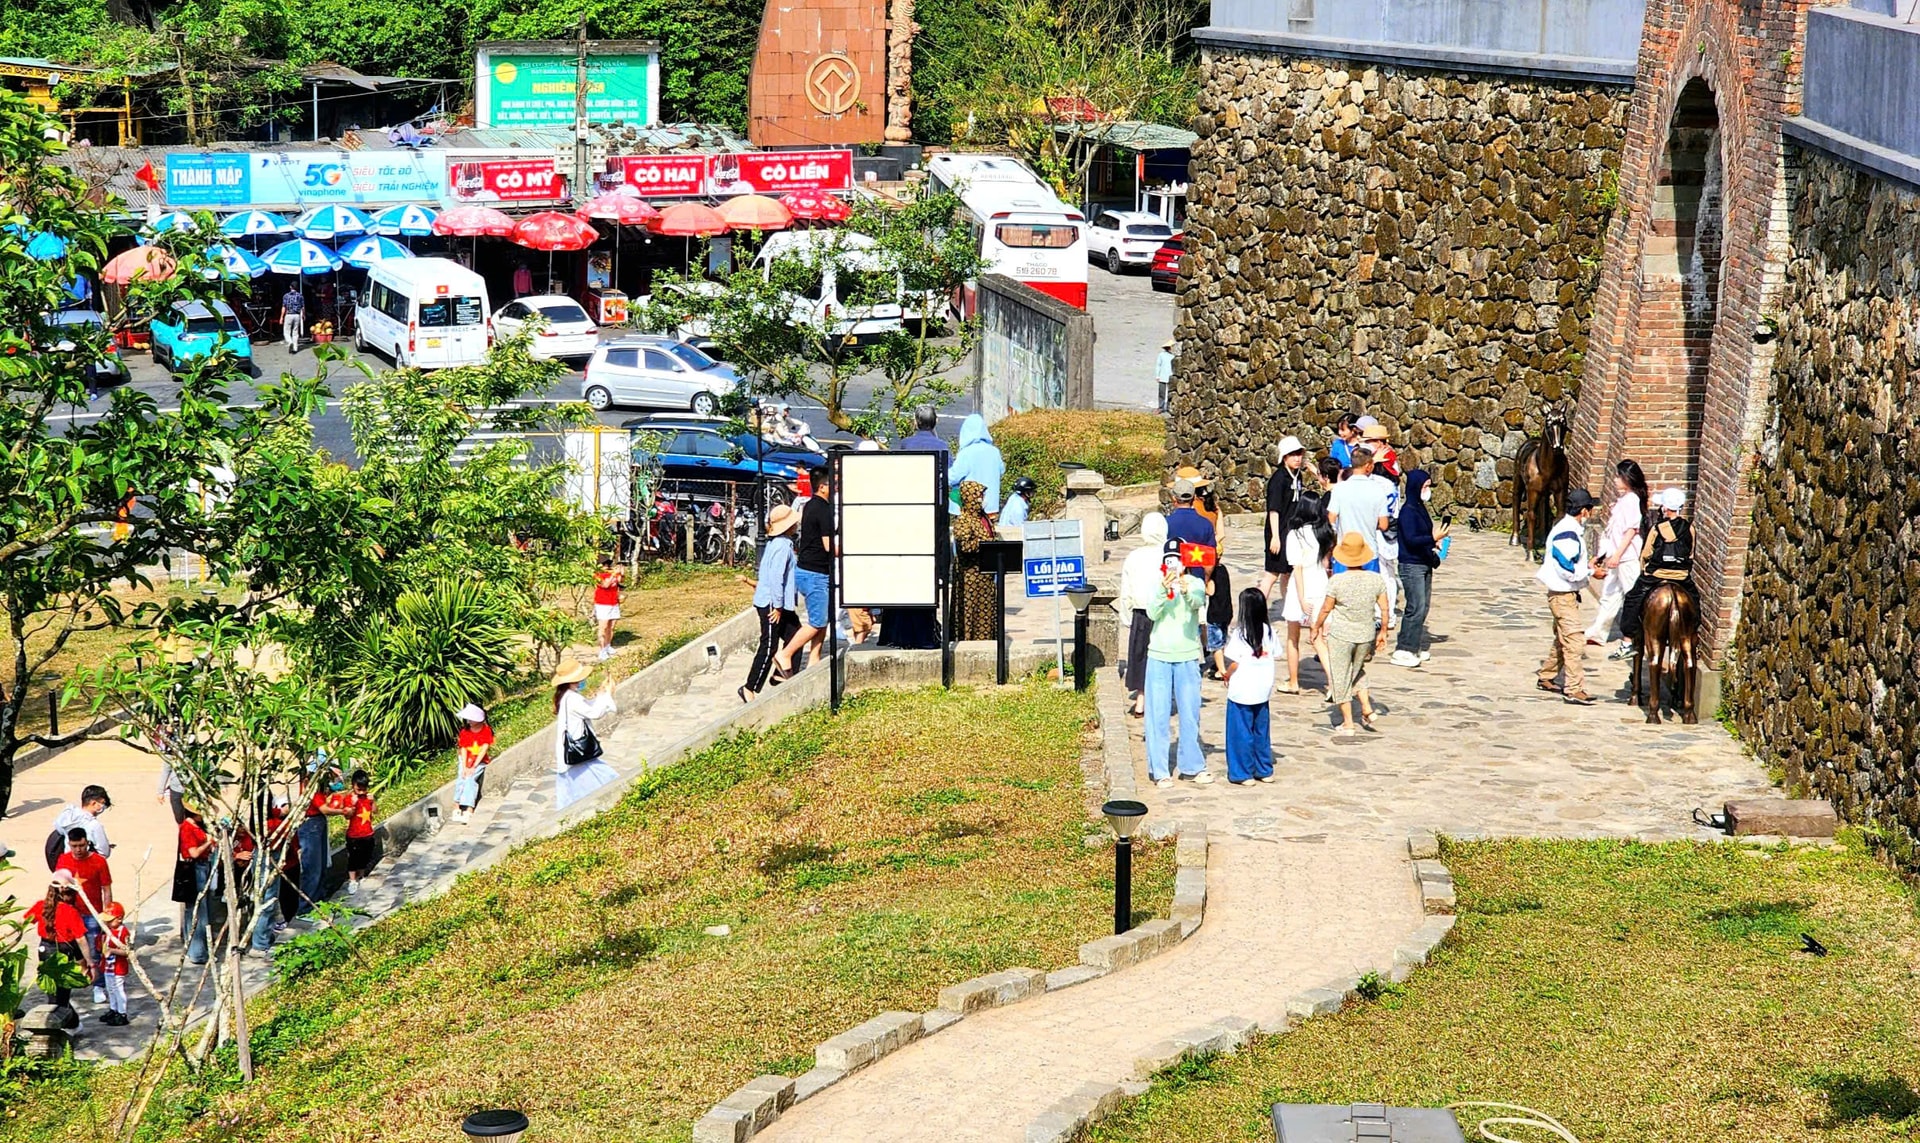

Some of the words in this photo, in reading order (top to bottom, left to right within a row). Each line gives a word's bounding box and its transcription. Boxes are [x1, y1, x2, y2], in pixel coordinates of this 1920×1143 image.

[171, 166, 213, 186] THÀNH
[215, 165, 243, 188] MẬP
[496, 170, 523, 189] CÔ
[635, 165, 661, 183] CÔ
[664, 167, 696, 182] HAI
[761, 163, 787, 181] CÔ
[299, 188, 346, 197] vinaphone
[1034, 562, 1051, 574] LỐI
